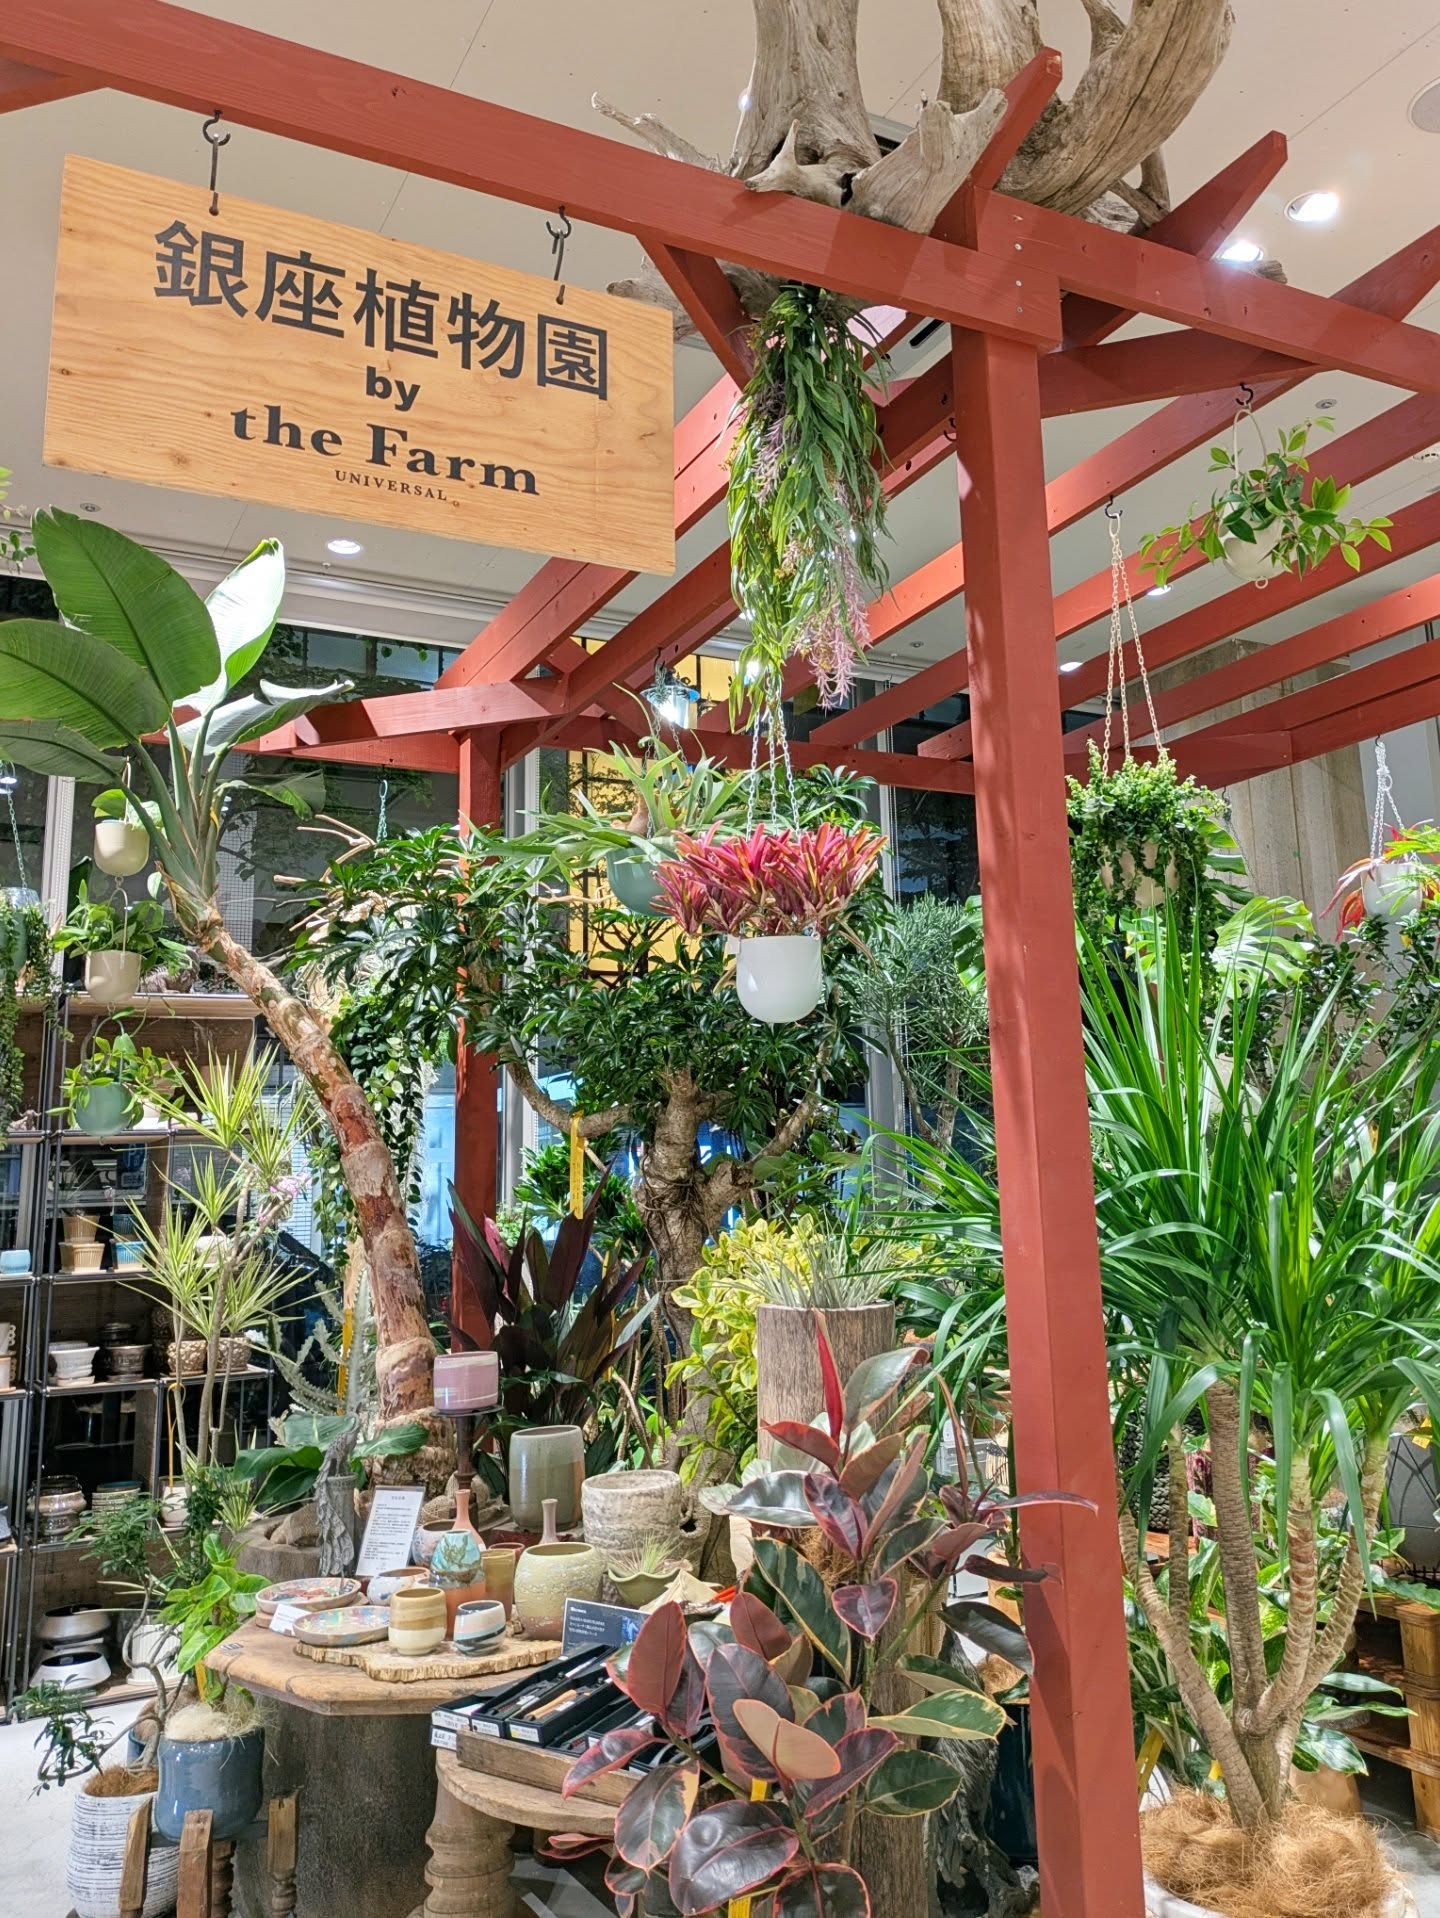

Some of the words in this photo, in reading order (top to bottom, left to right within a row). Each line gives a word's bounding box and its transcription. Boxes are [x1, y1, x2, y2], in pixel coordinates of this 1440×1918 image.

[153, 219, 609, 401] 銀座植物園
[366, 366, 421, 412] by
[230, 405, 343, 457] the
[364, 422, 541, 496] Farm
[334, 469, 448, 501] UNIVERSAL
